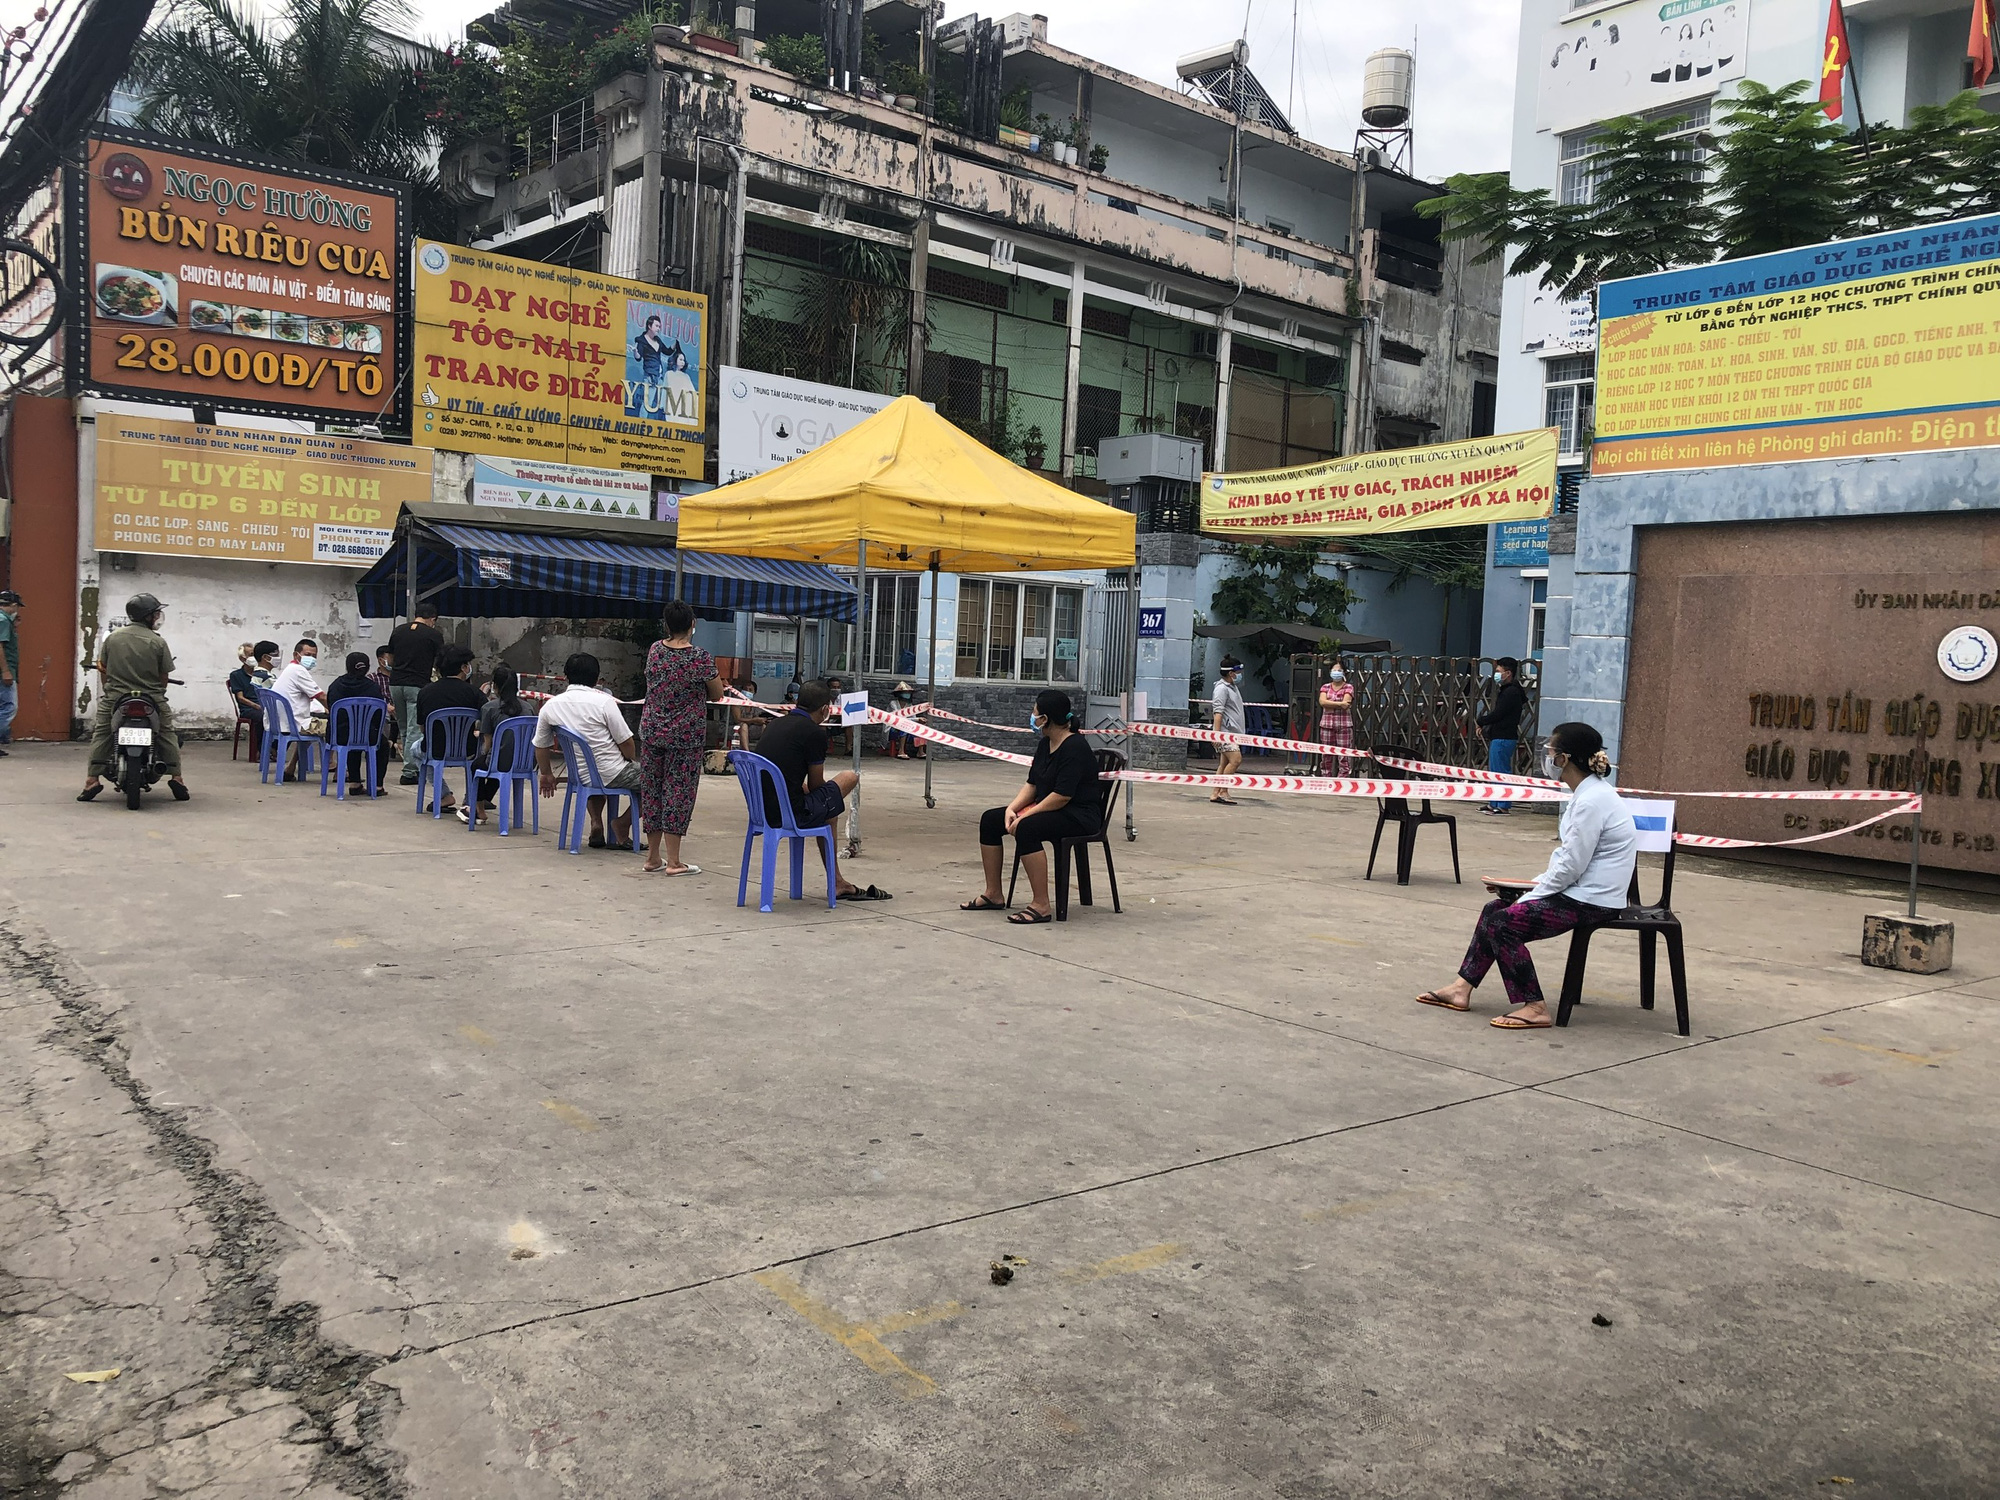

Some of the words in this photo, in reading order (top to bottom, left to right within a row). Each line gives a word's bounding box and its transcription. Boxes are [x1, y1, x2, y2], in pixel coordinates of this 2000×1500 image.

[163, 166, 257, 216] NGỌC
[263, 186, 372, 232] HƯỜNG
[120, 201, 208, 249] BÚN
[215, 221, 311, 266] RIÊU
[318, 242, 391, 280] CUA
[1856, 239, 1911, 258] BAN
[1921, 224, 2000, 247] NHÂN
[180, 264, 221, 287] CHUYÊN
[224, 268, 245, 290] CÁC
[247, 272, 270, 294] MÓN
[272, 275, 286, 296] ĂN
[316, 280, 341, 304] ĐIỂM
[343, 287, 364, 308] TÂM
[366, 291, 391, 312] SÁNG
[450, 254, 475, 266] TRUNG
[477, 258, 493, 270] TÂM
[495, 262, 515, 273] GIÁO
[517, 266, 532, 279] DỤC
[587, 279, 603, 290] GIÁO
[605, 284, 620, 295] DỤC
[651, 292, 674, 304] XUYÊN
[697, 301, 704, 310] 10
[1632, 290, 1701, 310] TRUNG
[1709, 280, 1756, 298] TÂM
[1764, 271, 1816, 290] GIÁO
[1825, 262, 1873, 281] DỤC
[1665, 311, 1682, 323] TỪ
[1686, 305, 1711, 321] LỚP
[1714, 307, 1723, 316] 6
[1726, 300, 1753, 314] ĐẾN
[1757, 297, 1784, 310] LỚP
[1790, 294, 1806, 305] 12
[1811, 289, 1840, 303] HỌC
[1844, 278, 1907, 297] CHƯƠNG
[1911, 270, 1960, 287] TRÌNH
[449, 279, 517, 313] DẠY
[525, 295, 611, 330] NGHỀ
[1700, 316, 1735, 332] BẰNG
[1739, 312, 1766, 326] TỐT
[1769, 306, 1822, 324] NGHIỆP
[1872, 293, 1913, 307] THPT
[1918, 285, 1967, 302] CHÍNH
[448, 316, 514, 351] TÓC
[531, 333, 606, 367] NAIL
[1632, 317, 1651, 333] SINH
[116, 333, 384, 397] 28.000Đ/TÔ
[424, 353, 540, 392] TRANG
[548, 366, 623, 405] ĐIỂM
[1734, 370, 1762, 385] THEO
[620, 379, 699, 419] YUMI
[753, 386, 770, 396] TRUNG
[1784, 383, 1815, 397] THPT
[1853, 376, 1872, 390] GIA
[441, 413, 451, 423] Số
[452, 416, 464, 424] 367
[527, 426, 534, 434] 10
[447, 397, 461, 412] UY
[466, 396, 484, 415] TÍN
[493, 401, 521, 419] CHẤT
[525, 407, 561, 426] LƯỢNG
[570, 414, 611, 431] CHUYÊN
[614, 421, 653, 438] NGHIỆP
[657, 426, 672, 442] TẠI
[675, 428, 705, 444] TPHCM
[1674, 415, 1691, 427] THI
[1755, 405, 1777, 418] ANH
[1815, 400, 1835, 413] TIN
[120, 430, 156, 441] TRUNG
[215, 429, 239, 438] BAN
[340, 443, 353, 451] 10
[439, 427, 458, 436] (028)
[460, 430, 491, 440] 39271980
[497, 434, 524, 444] Hotline:
[602, 436, 619, 445] Web:
[752, 410, 837, 459] YOGA
[1597, 448, 1622, 468] Mọi
[1625, 447, 1647, 463] chi
[1651, 442, 1674, 461] tiết
[1677, 444, 1700, 459] xin
[1704, 441, 1732, 457] liên
[1736, 437, 1756, 458] hệ
[1761, 434, 1814, 454] Phòng
[1818, 430, 1847, 453] ghi
[1851, 426, 1903, 446] danh:
[1910, 416, 1976, 446] Điện
[1365, 457, 1387, 469] GIÁO
[1389, 456, 1407, 469] DỤC
[1450, 445, 1483, 459] XUYÊN
[162, 459, 285, 492] TUYỂN
[299, 472, 381, 501] SINH
[592, 477, 603, 487] thi
[603, 478, 613, 488] lái
[613, 481, 622, 489] xe
[632, 481, 649, 492] bánh
[1227, 494, 1260, 509] KHAI
[1264, 489, 1292, 506] BÁO
[1295, 490, 1305, 502] Y
[1308, 483, 1325, 501] TẾ
[1329, 484, 1349, 502] TỰ
[1354, 478, 1397, 497] GIÁC,
[1401, 473, 1454, 492] TRÁCH
[1460, 464, 1519, 486] NHIỆM
[158, 488, 219, 511] LỚP
[229, 496, 248, 513] 6
[258, 497, 319, 519] ĐẾN
[328, 503, 382, 524] LỚP
[1327, 505, 1373, 522] THÂN,
[1377, 503, 1407, 520] GIA
[1459, 491, 1482, 508] VÀ
[1516, 484, 1550, 506] HỘI
[364, 537, 385, 546] GHI
[1502, 540, 1520, 549] seed
[1522, 539, 1530, 548] of
[1503, 525, 1537, 535] Learning
[318, 543, 331, 553] ĐT:
[332, 544, 383, 556] 028.66803610
[1881, 593, 1918, 609] BAN
[1922, 589, 1975, 609] NHÂN
[1142, 613, 1162, 628] 367
[1749, 692, 1817, 730] TRUNG
[1884, 692, 1942, 738] GIÁO
[1745, 738, 1796, 781] GIÁO
[1807, 747, 1851, 791] DỤC
